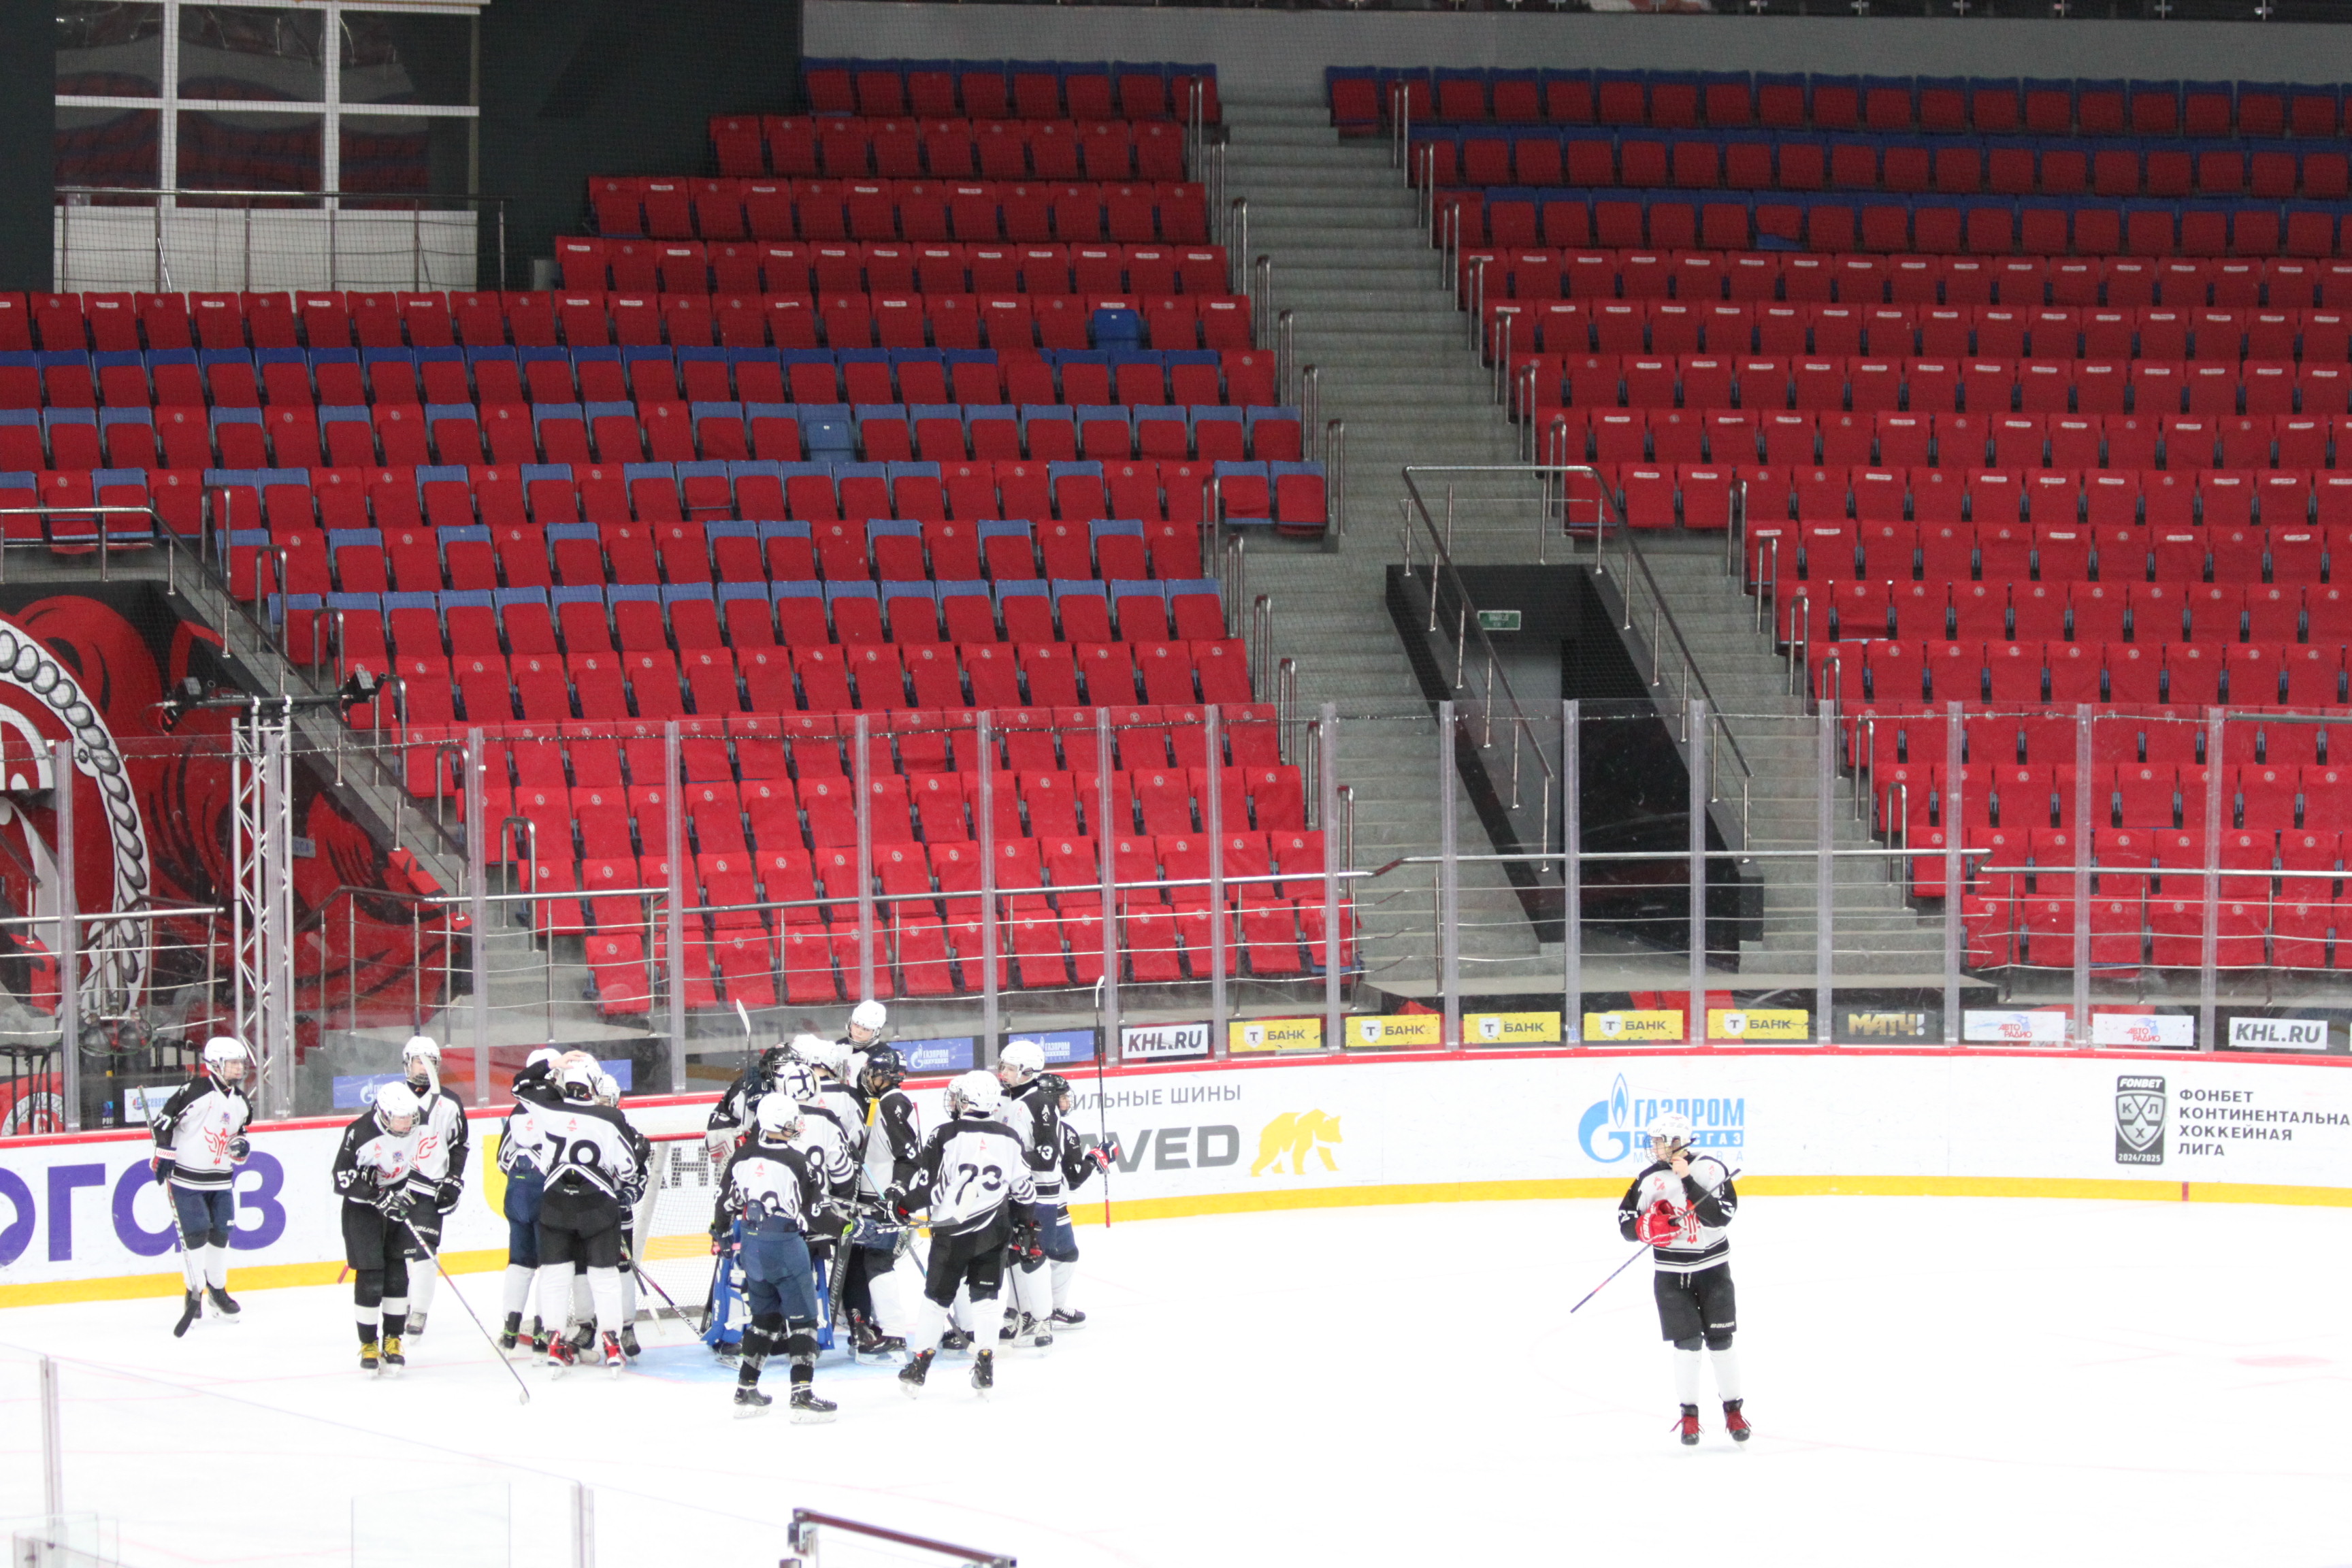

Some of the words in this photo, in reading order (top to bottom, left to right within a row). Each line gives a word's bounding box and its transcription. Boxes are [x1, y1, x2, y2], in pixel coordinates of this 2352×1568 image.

[1504, 1022, 1544, 1033] БАНК
[1624, 1020, 1667, 1031] БАНК
[1749, 1018, 1791, 1029] БАНК
[1848, 1013, 1925, 1036] МАТЧ!
[1267, 1029, 1305, 1041] БАНК
[1384, 1024, 1424, 1036] БАНК
[2004, 1030, 2032, 1039] РАДИО
[2236, 1023, 2321, 1043] KHL.RU
[1128, 1030, 1202, 1052] KHL.RU
[2132, 1034, 2161, 1042] РАДИО
[2119, 1078, 2163, 1089] FONBET
[1171, 1085, 1241, 1104] ШИНЫ
[2179, 1089, 2254, 1103] ФОНБЕТ
[2179, 1124, 2293, 1141] ХОККЕЙНАЯ
[1637, 1132, 1742, 1146] ТСГАЗ
[2178, 1143, 2225, 1156] ЛИГА
[1633, 1150, 1744, 1163] МВА
[2118, 1153, 2161, 1163] 2024/2025
[415, 1226, 439, 1236] AUER
